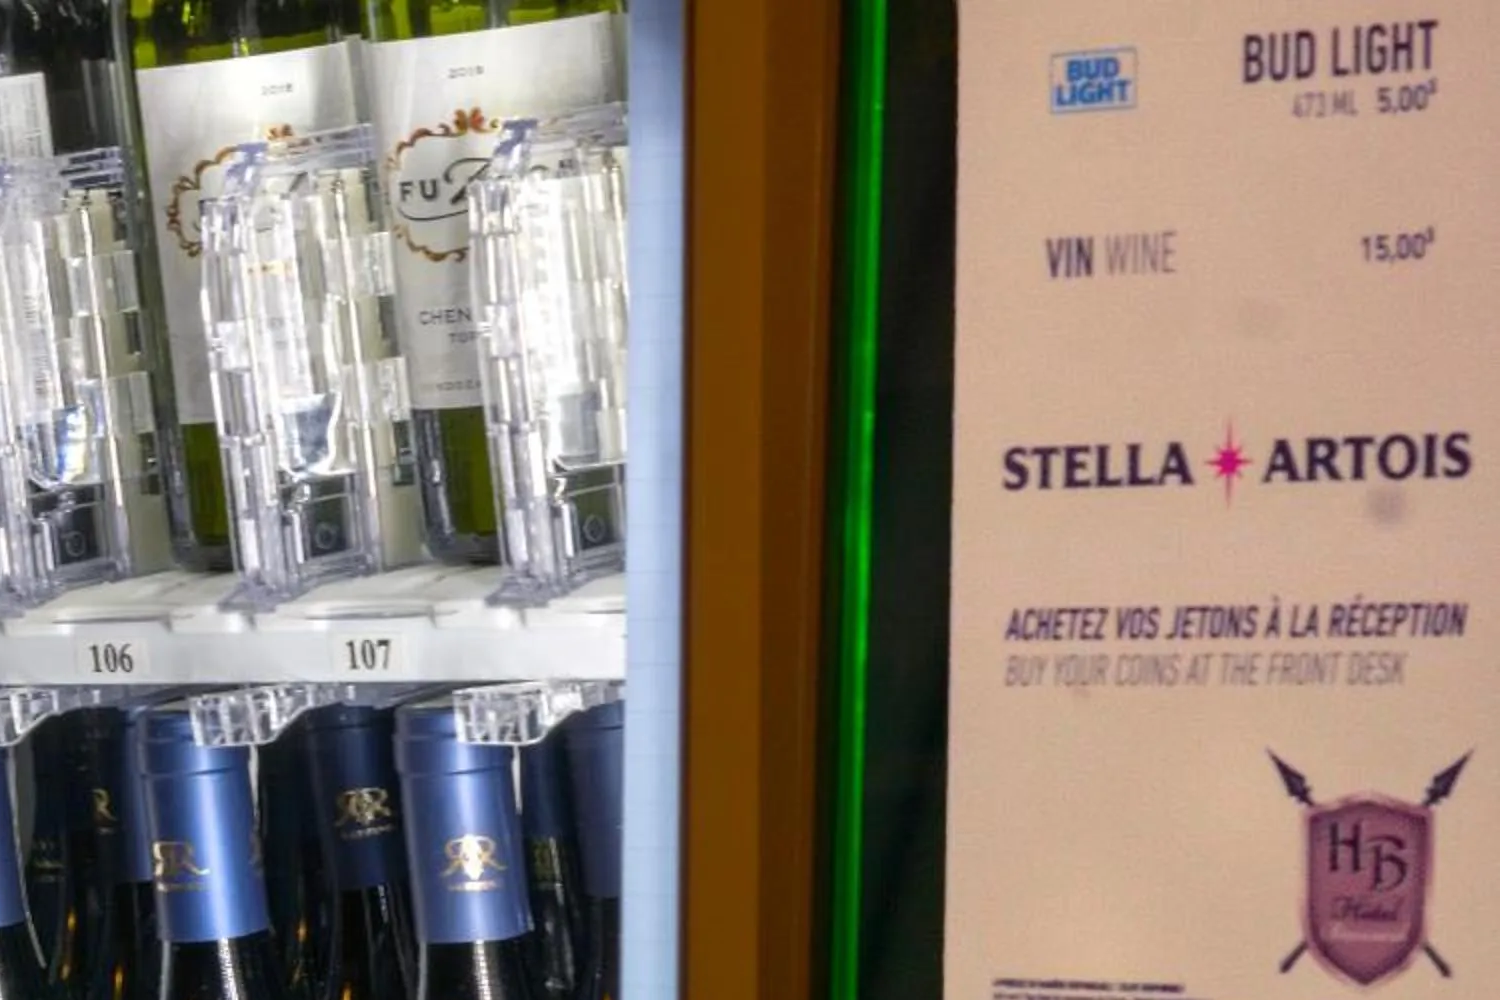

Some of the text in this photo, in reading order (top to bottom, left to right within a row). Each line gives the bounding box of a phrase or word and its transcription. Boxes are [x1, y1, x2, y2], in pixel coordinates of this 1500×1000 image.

[1243, 20, 1439, 83] BUD LIGHT
[1055, 57, 1132, 107] BUD LIGHT
[1046, 229, 1178, 279] VIN WINE
[1003, 432, 1472, 491] STELLA ARTOIS
[1005, 594, 1469, 642] ACHETEZ VOS JETONS À LA RÉCEPTION
[90, 642, 135, 674] 106
[345, 638, 393, 672] 107
[1005, 650, 1410, 689] BUY YOUR COINS AT THE FRONT DESK
